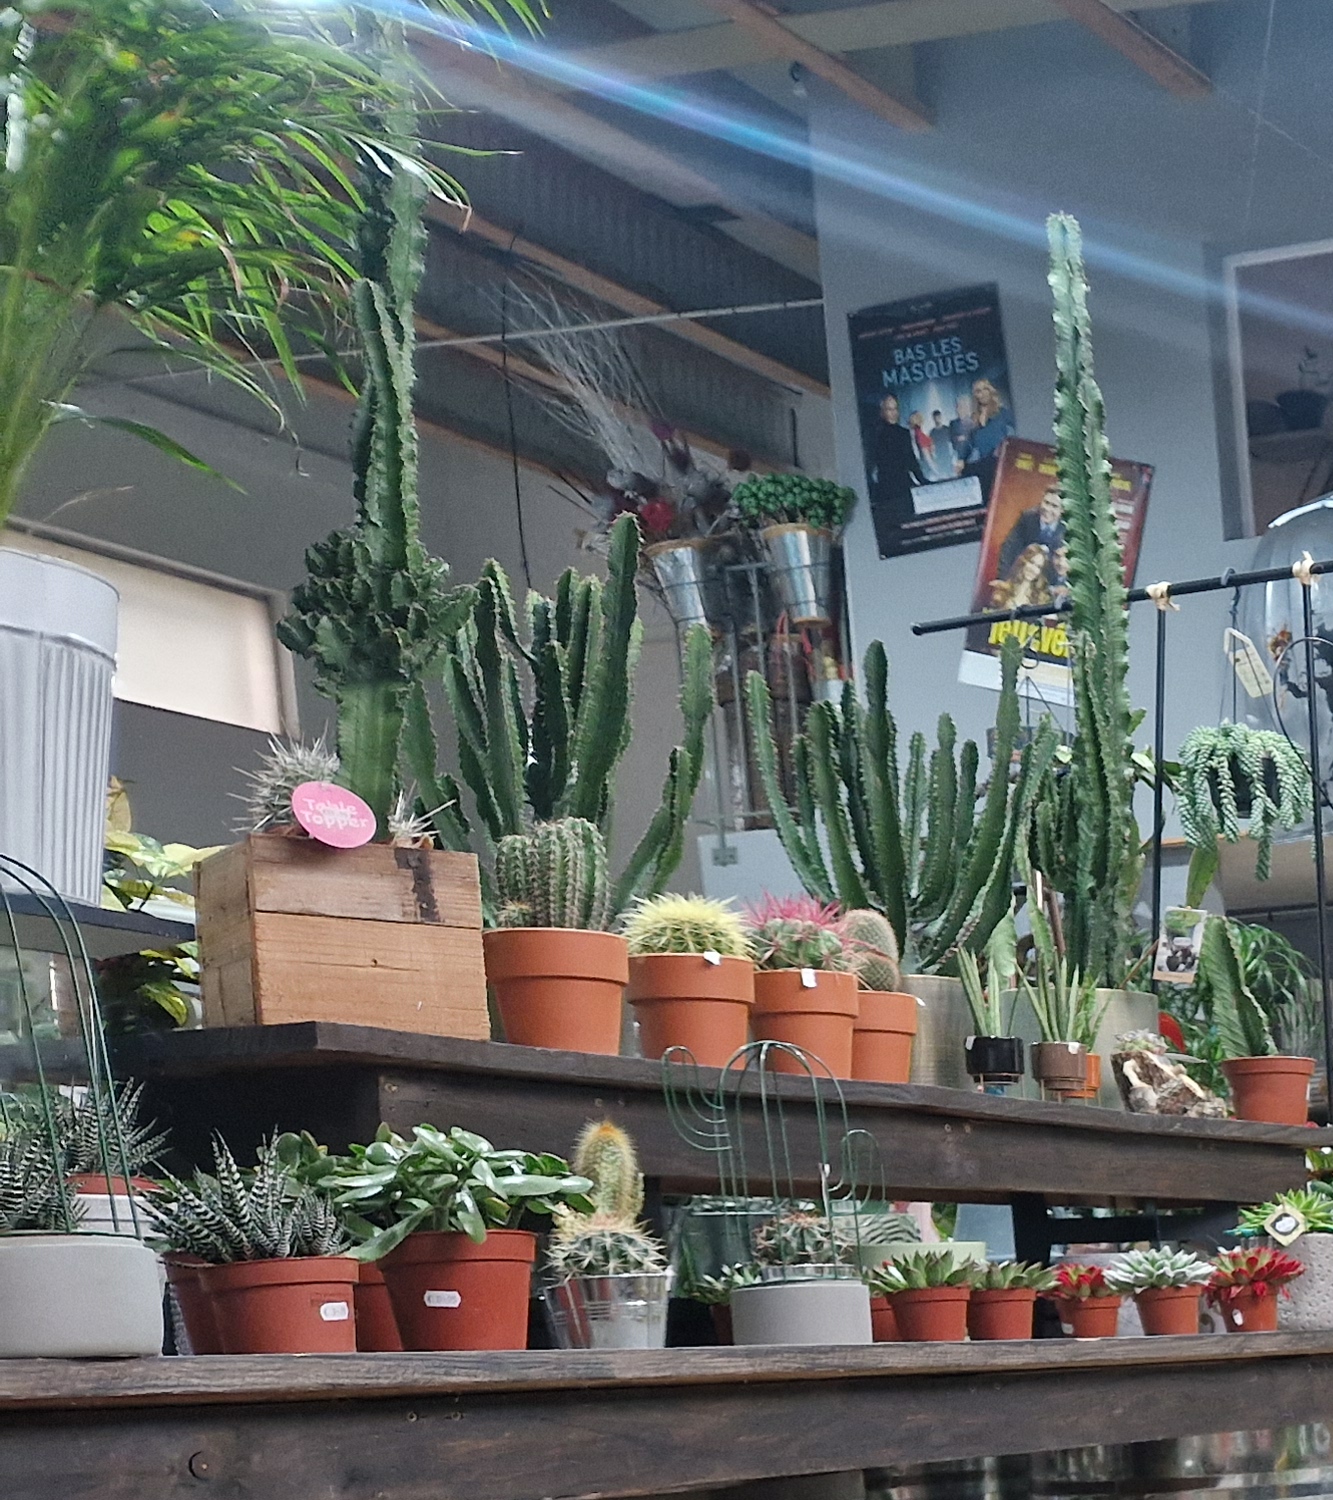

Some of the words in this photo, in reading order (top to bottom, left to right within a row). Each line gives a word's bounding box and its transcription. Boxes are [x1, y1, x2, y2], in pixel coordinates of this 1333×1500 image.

[893, 344, 927, 366] BAS
[931, 337, 963, 358] LES
[881, 351, 981, 388] MASQUES
[301, 798, 358, 816] Table
[300, 810, 369, 830] Topper
